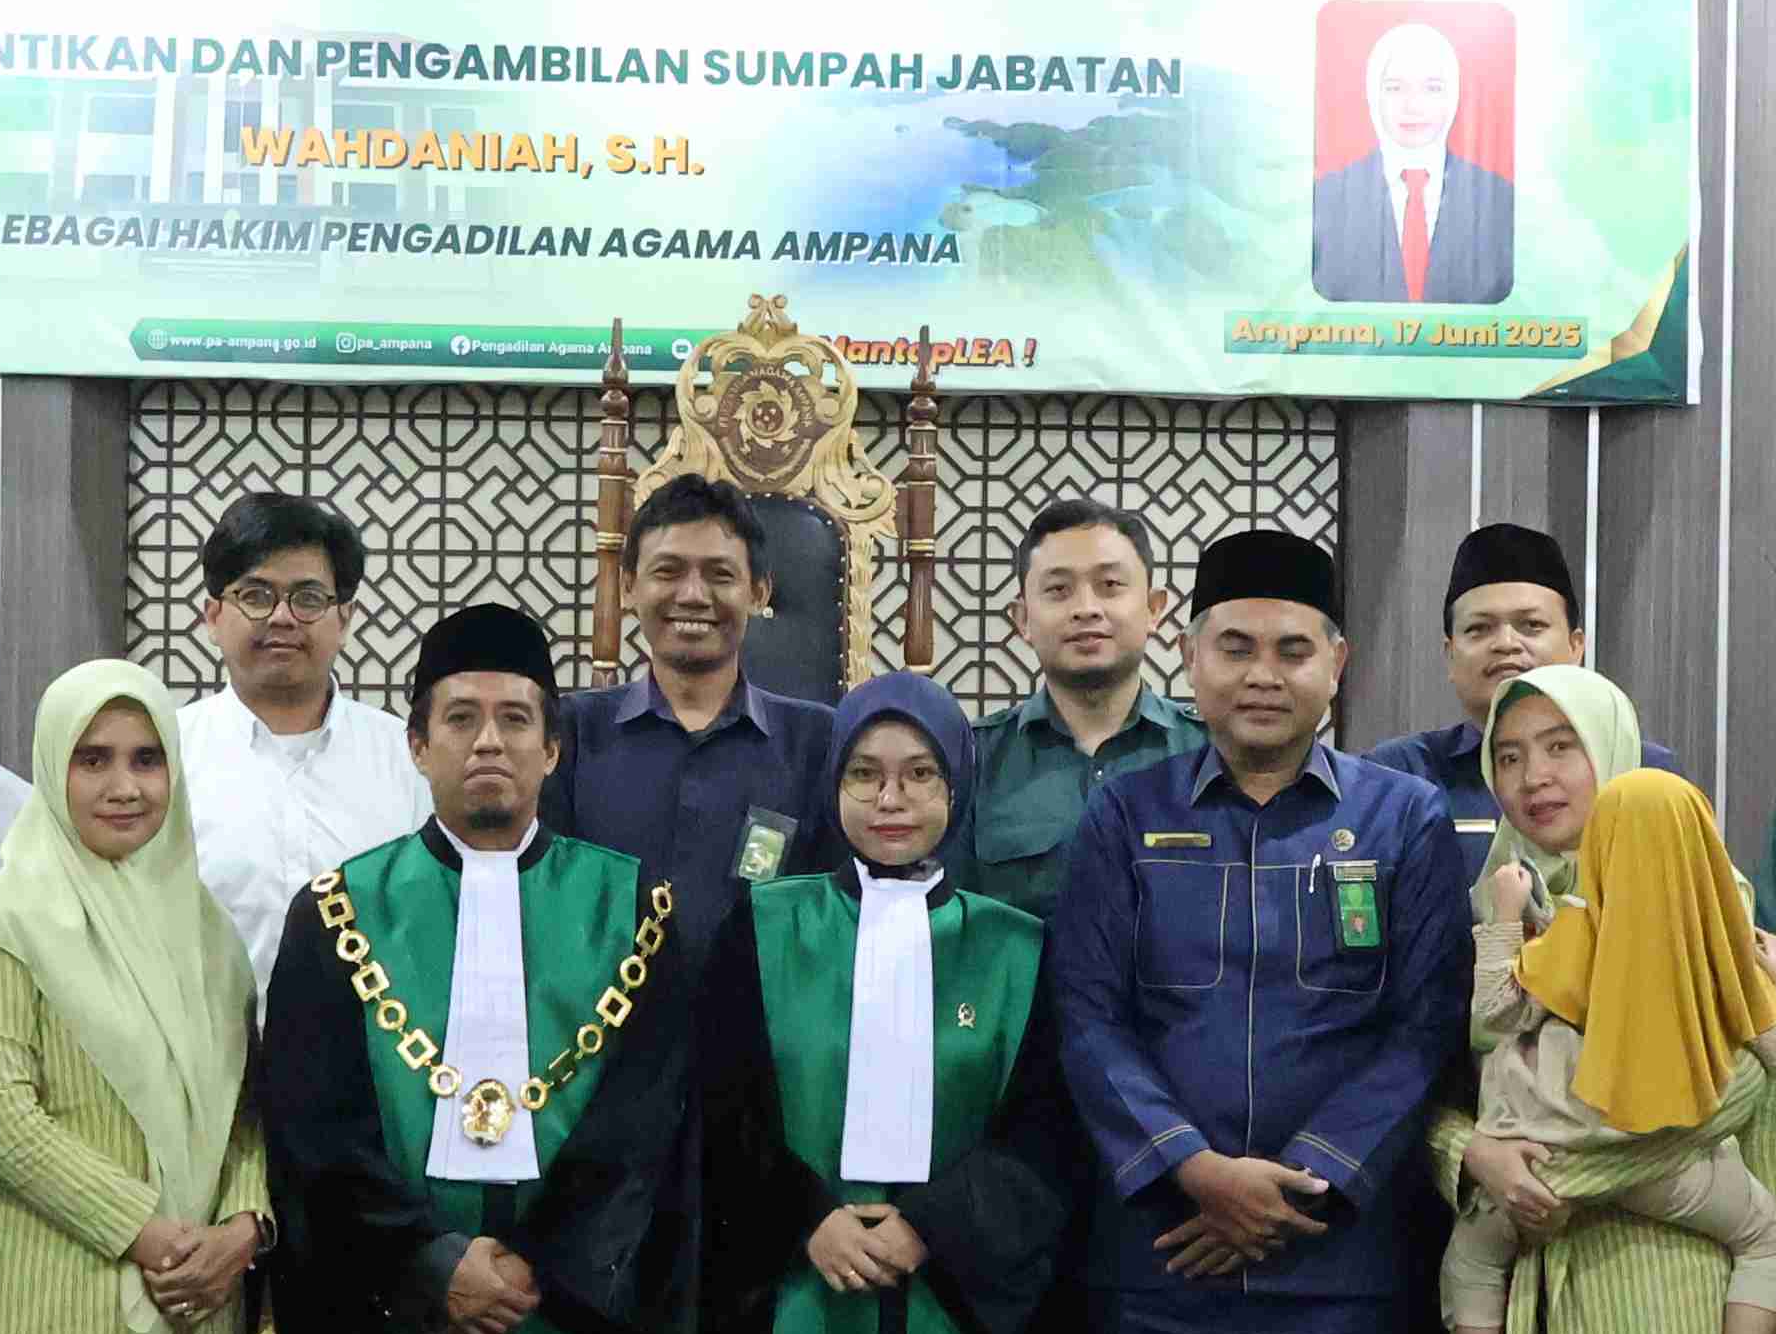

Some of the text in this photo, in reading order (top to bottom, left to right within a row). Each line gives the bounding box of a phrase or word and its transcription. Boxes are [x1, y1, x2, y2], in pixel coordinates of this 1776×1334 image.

[192, 37, 303, 77] DAN
[316, 40, 689, 86] PENGAMBILAN
[703, 49, 924, 90] SUMPAH
[935, 54, 1184, 96] JABATAN
[240, 126, 706, 179] WAHDANIAH, S.H.
[168, 216, 315, 253] HAKIM
[320, 220, 592, 258] PENGADILAN
[599, 227, 763, 261] AGAMA
[771, 230, 962, 264] AMPANA
[471, 339, 545, 355] Pengadilan
[547, 341, 595, 356] Agama
[1023, 337, 1037, 367] !
[1233, 318, 1583, 351] Ampana, 17 Juni 2025
